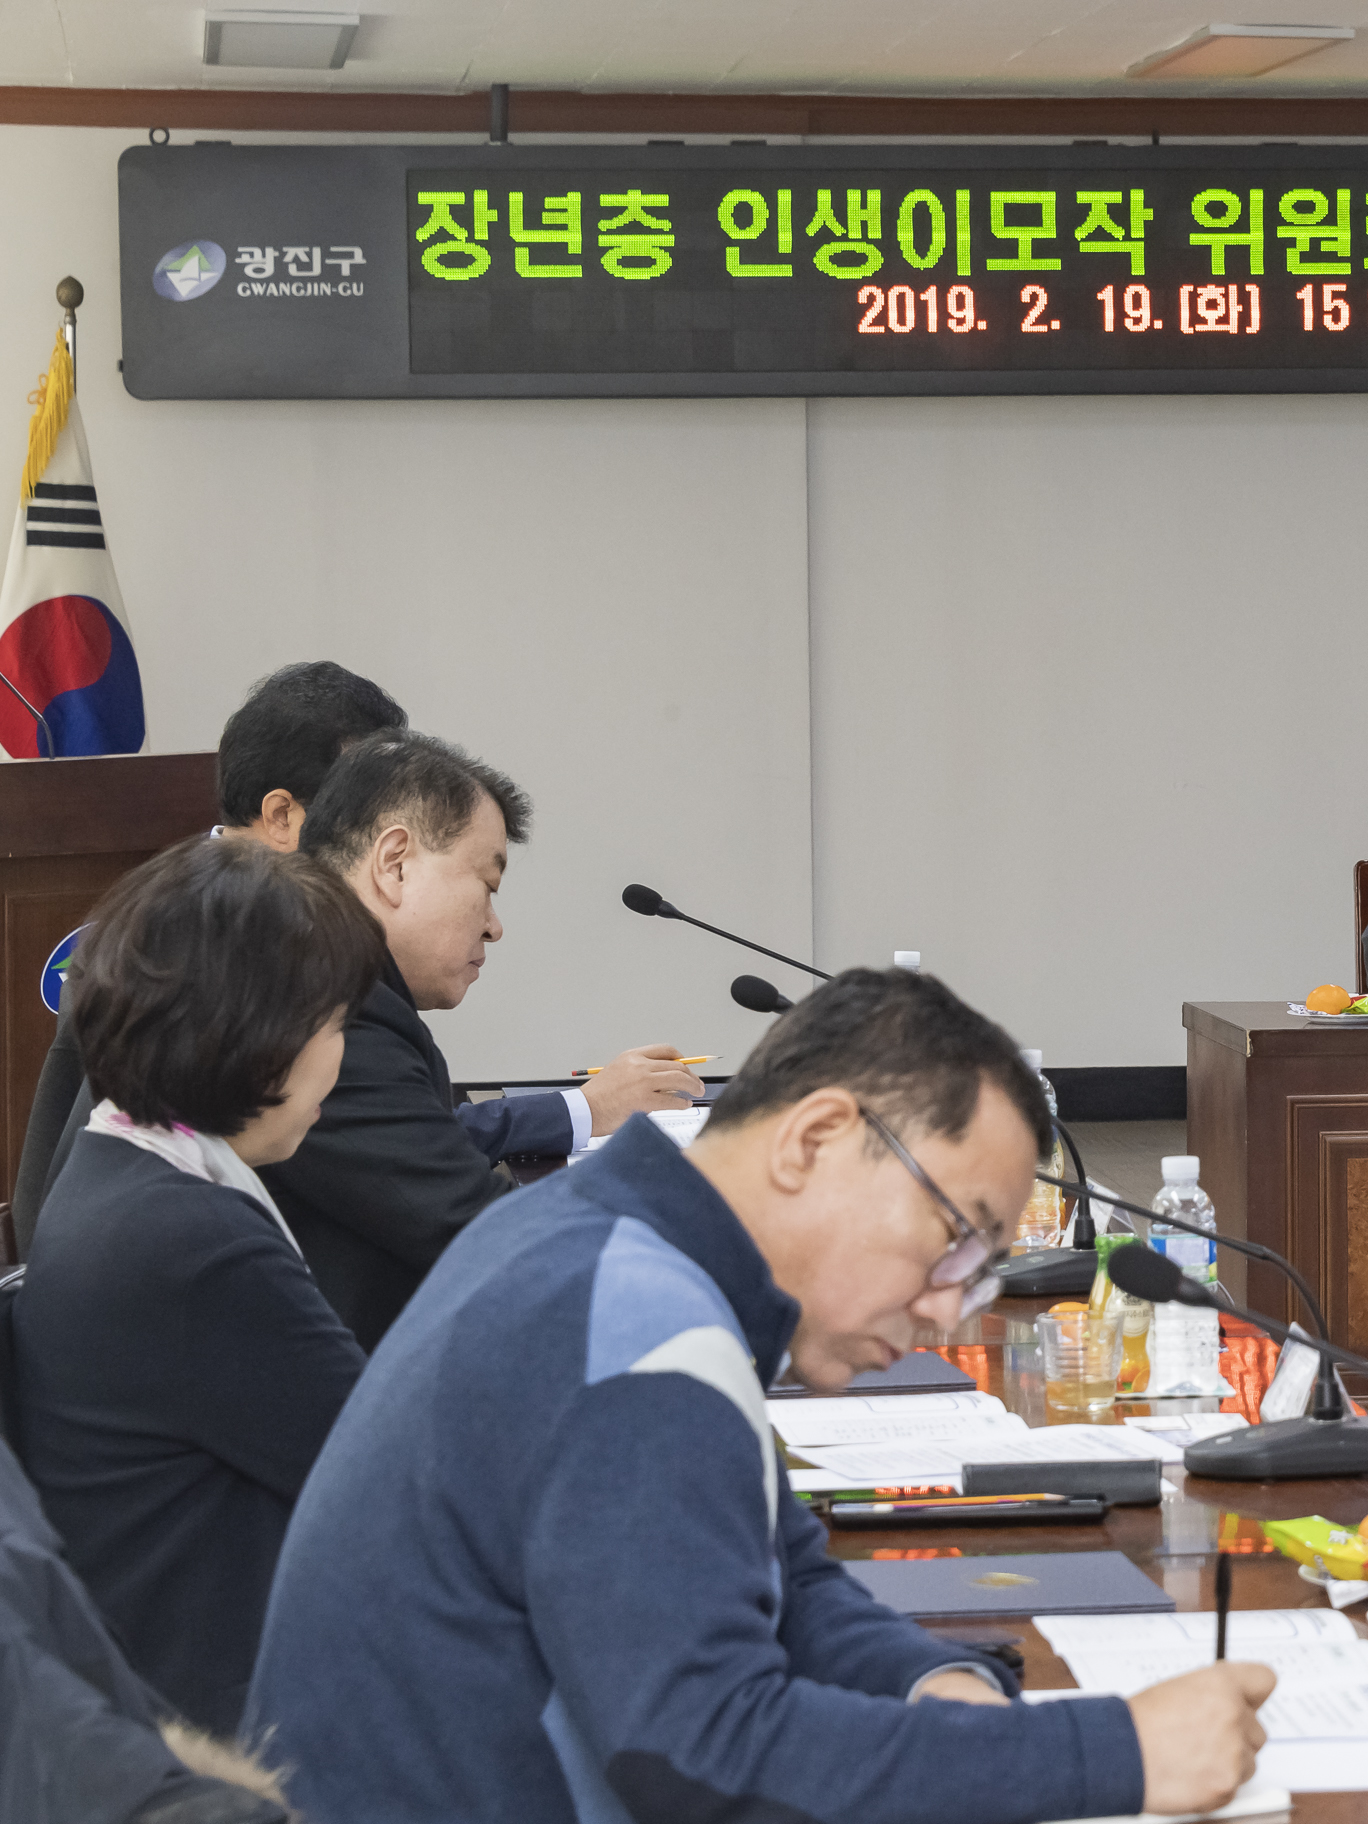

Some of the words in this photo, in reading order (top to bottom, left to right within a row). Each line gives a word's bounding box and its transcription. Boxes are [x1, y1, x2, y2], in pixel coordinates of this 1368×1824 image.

[415, 188, 676, 281] 장년층
[717, 188, 1154, 280] 인생이모작
[234, 245, 368, 279] 광진구
[236, 281, 365, 297] GWANGJIN-GU
[856, 284, 988, 334] 2019.
[1020, 284, 1061, 333] 2.
